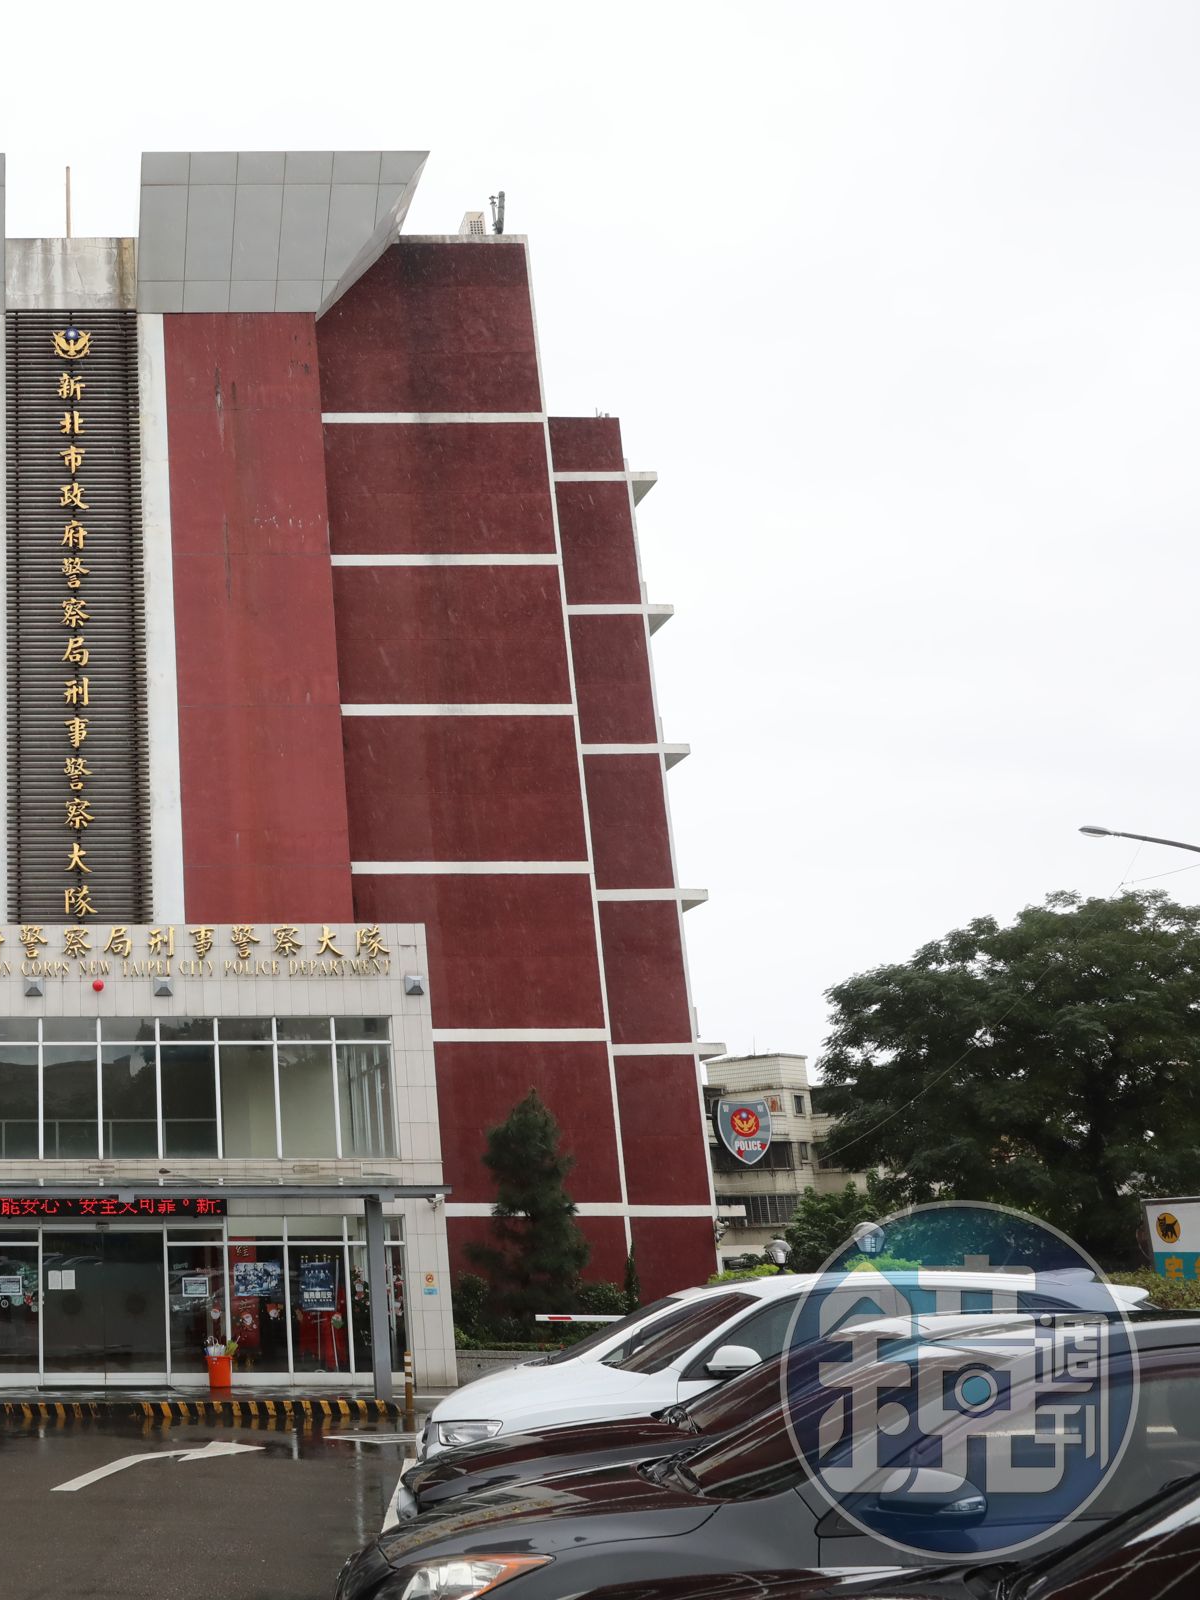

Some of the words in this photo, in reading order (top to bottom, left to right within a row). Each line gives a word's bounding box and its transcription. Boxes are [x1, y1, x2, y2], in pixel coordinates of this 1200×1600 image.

[57, 372, 98, 917] 新北市政府警察局刑事警察大隊
[21, 959, 70, 977] CORPS
[79, 959, 112, 977] NEW
[122, 959, 170, 977] TAIPEI
[179, 959, 216, 977] CITY
[224, 959, 280, 977] POLICE
[289, 959, 391, 977] DEPARTMENT
[734, 1140, 762, 1151] POLICE
